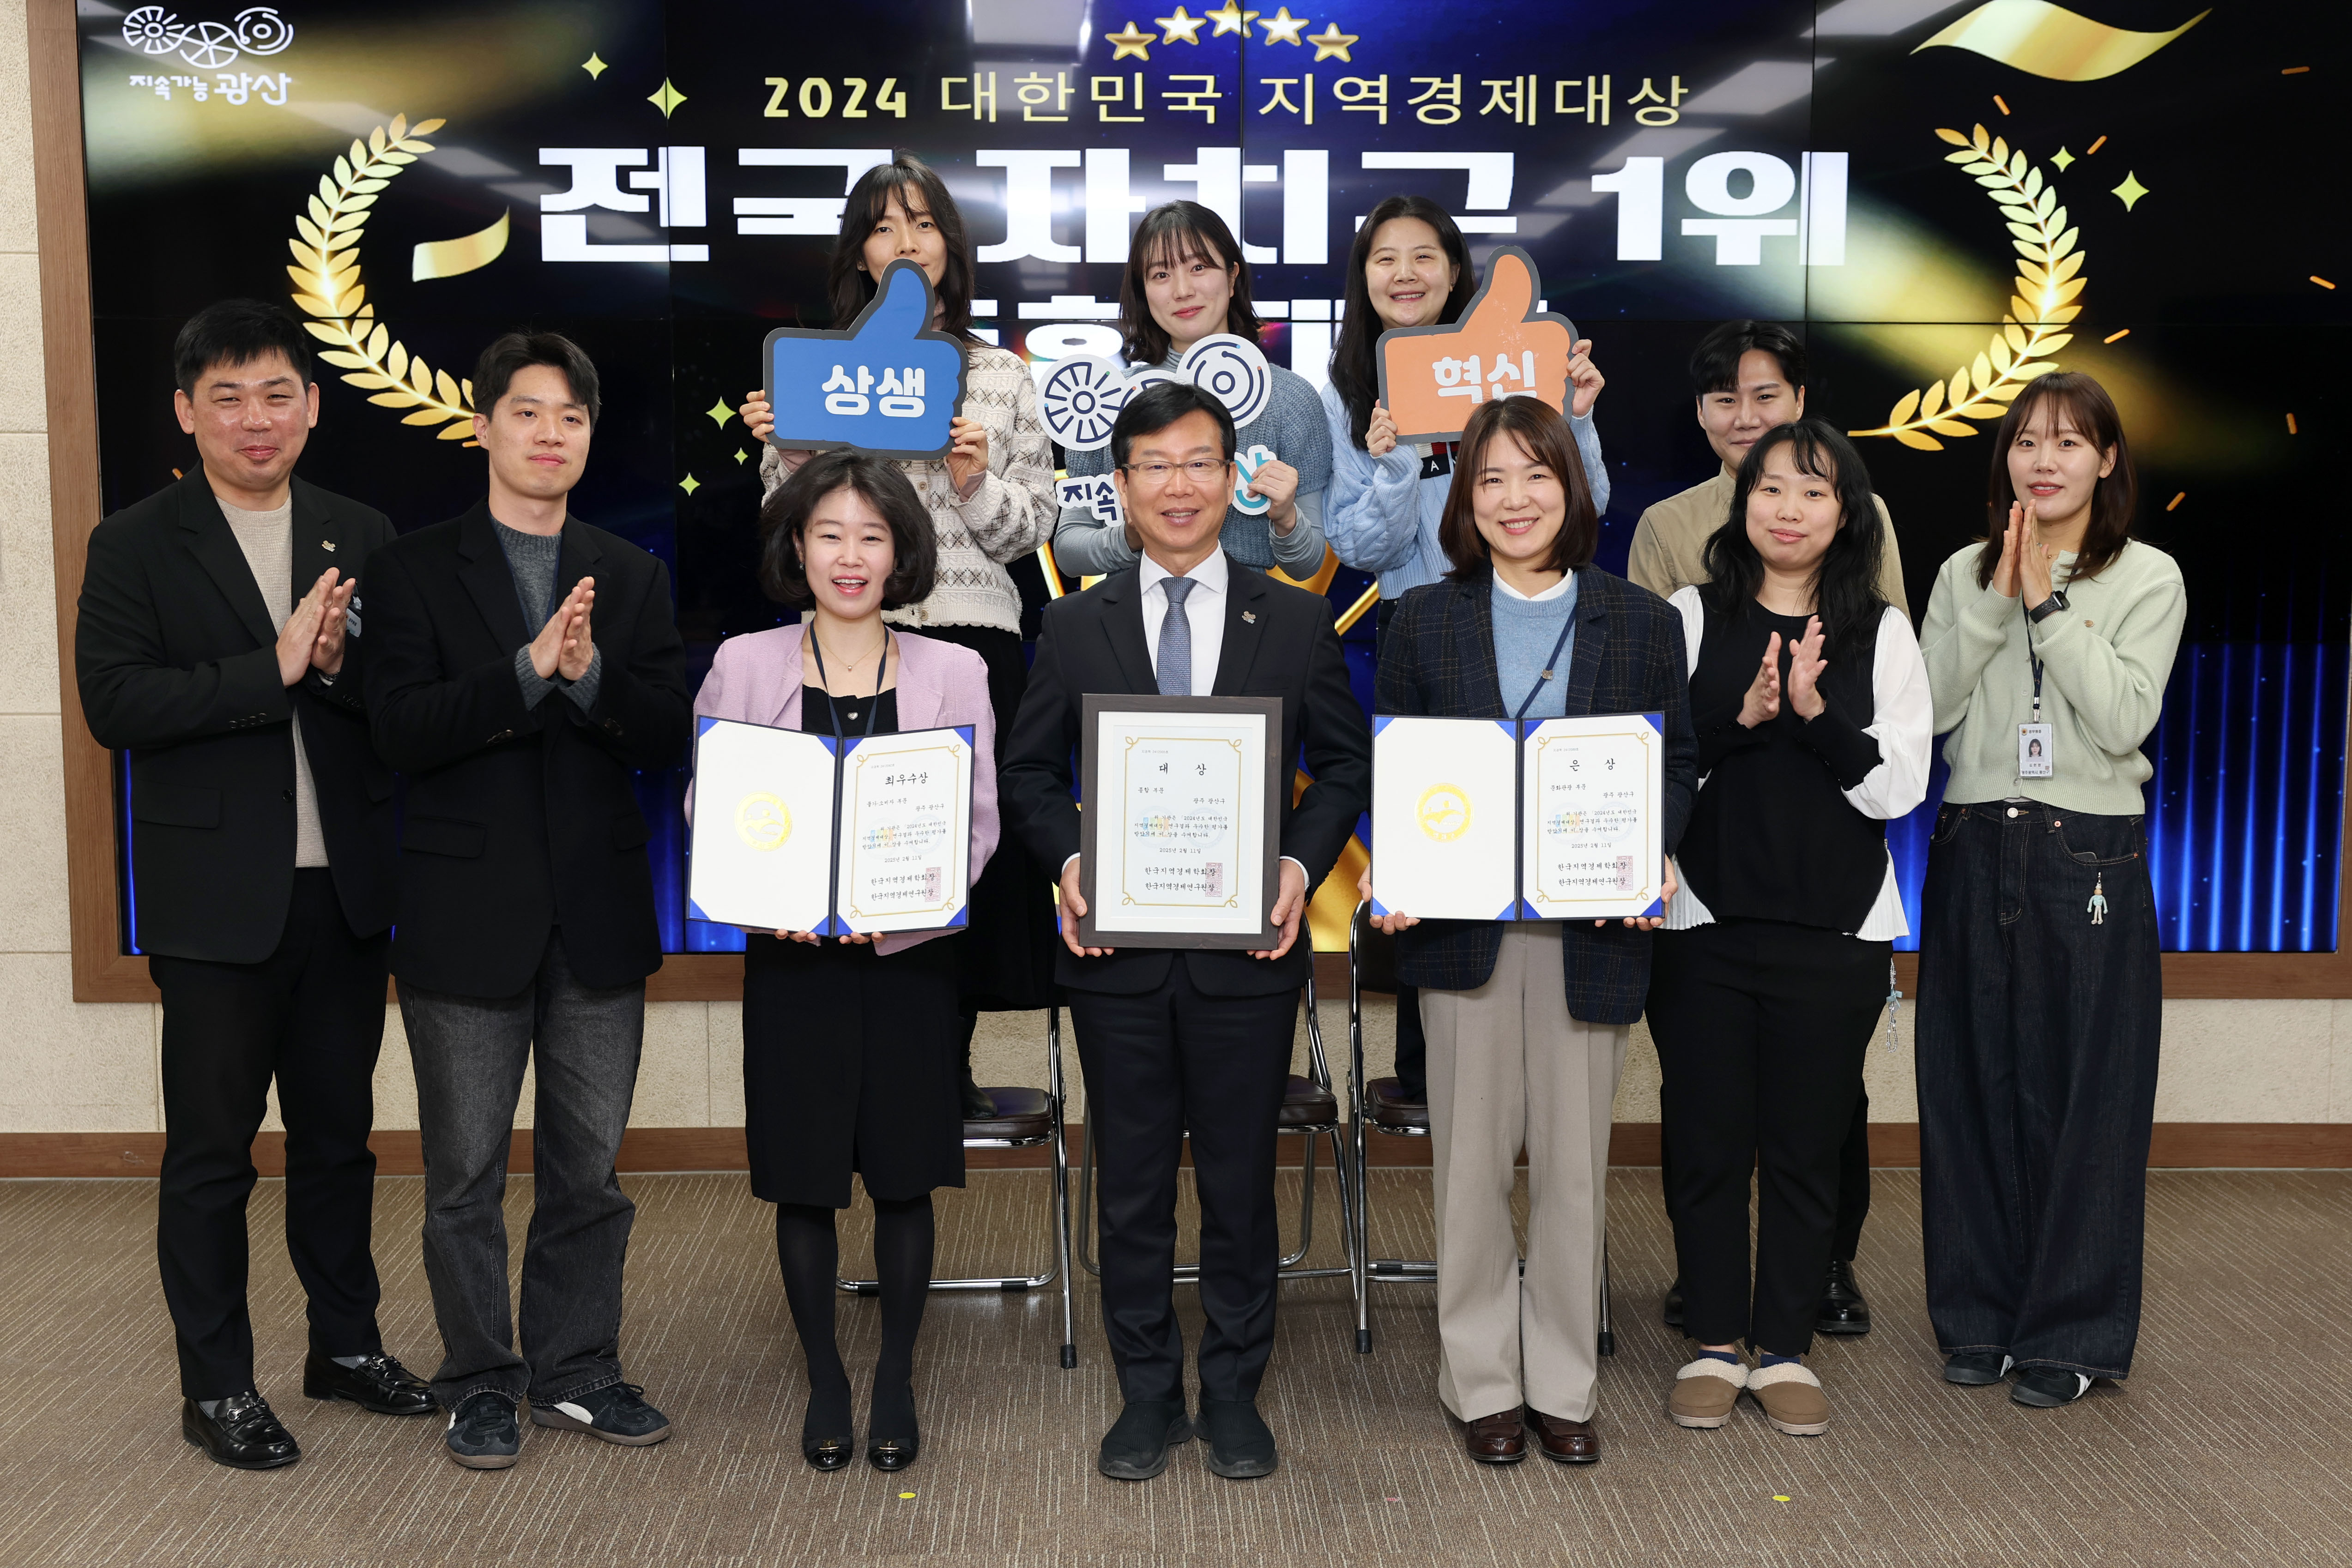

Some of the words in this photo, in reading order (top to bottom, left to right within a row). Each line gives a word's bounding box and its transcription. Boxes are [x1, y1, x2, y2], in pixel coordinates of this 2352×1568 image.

[130, 75, 208, 101] 지속가능
[214, 73, 292, 105] 광산
[764, 77, 907, 118] 2024
[941, 72, 1223, 124] 대한민국
[1258, 73, 1689, 126] 지역경제대상
[1591, 151, 1849, 266] 1위
[822, 363, 926, 417] 상생
[1432, 350, 1537, 404] 혁신
[885, 772, 928, 786] 최우수상
